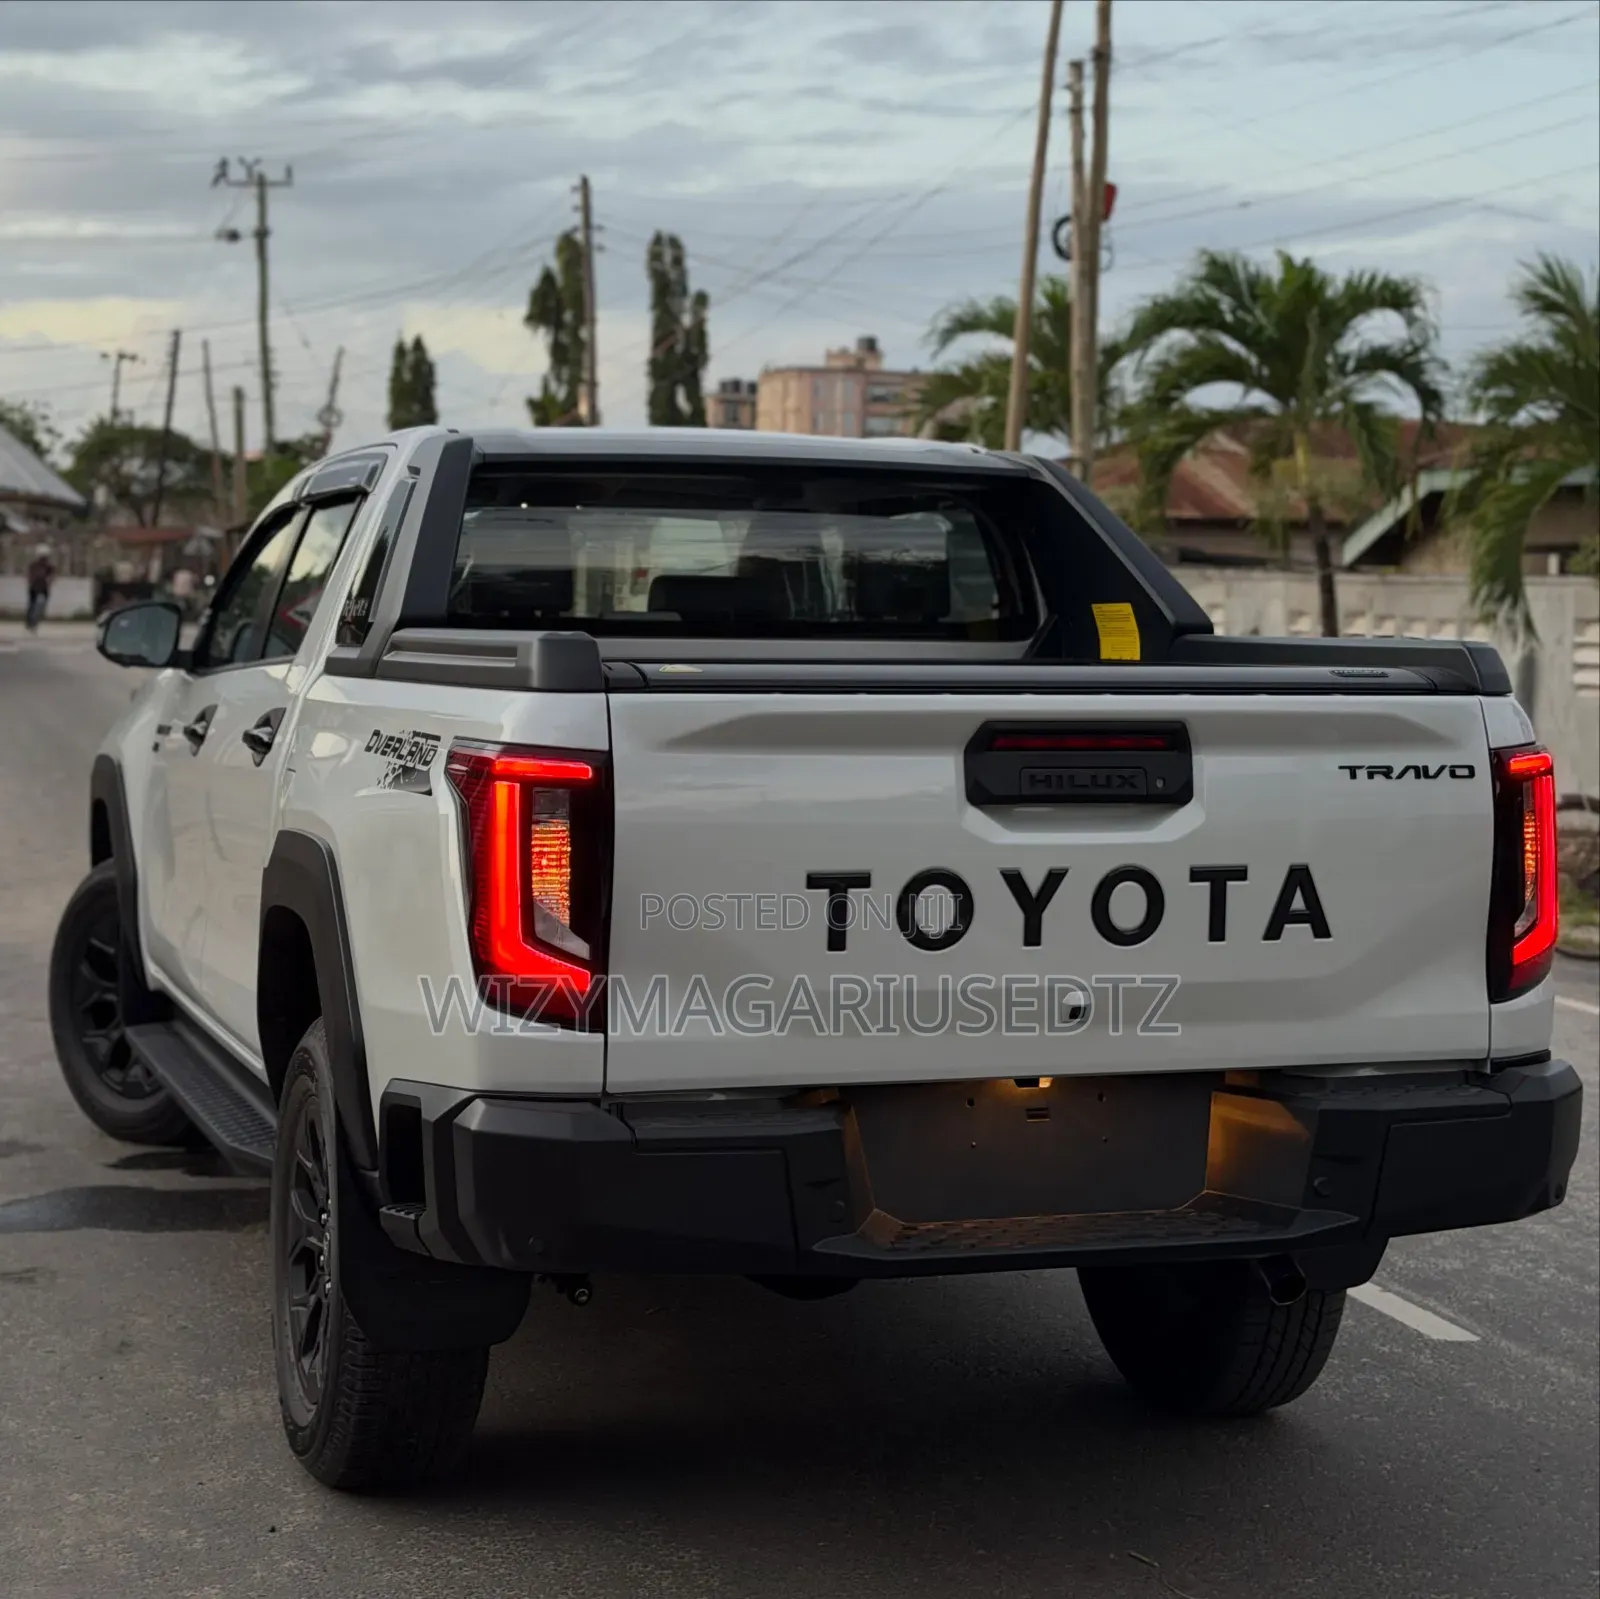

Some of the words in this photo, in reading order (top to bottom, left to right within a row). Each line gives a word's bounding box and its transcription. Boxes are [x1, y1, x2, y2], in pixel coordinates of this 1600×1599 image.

[364, 729, 438, 767] OVERLAND
[1027, 773, 1139, 790] HILUX
[1338, 764, 1476, 780] TRAVO
[806, 863, 1333, 953] TOYOTA
